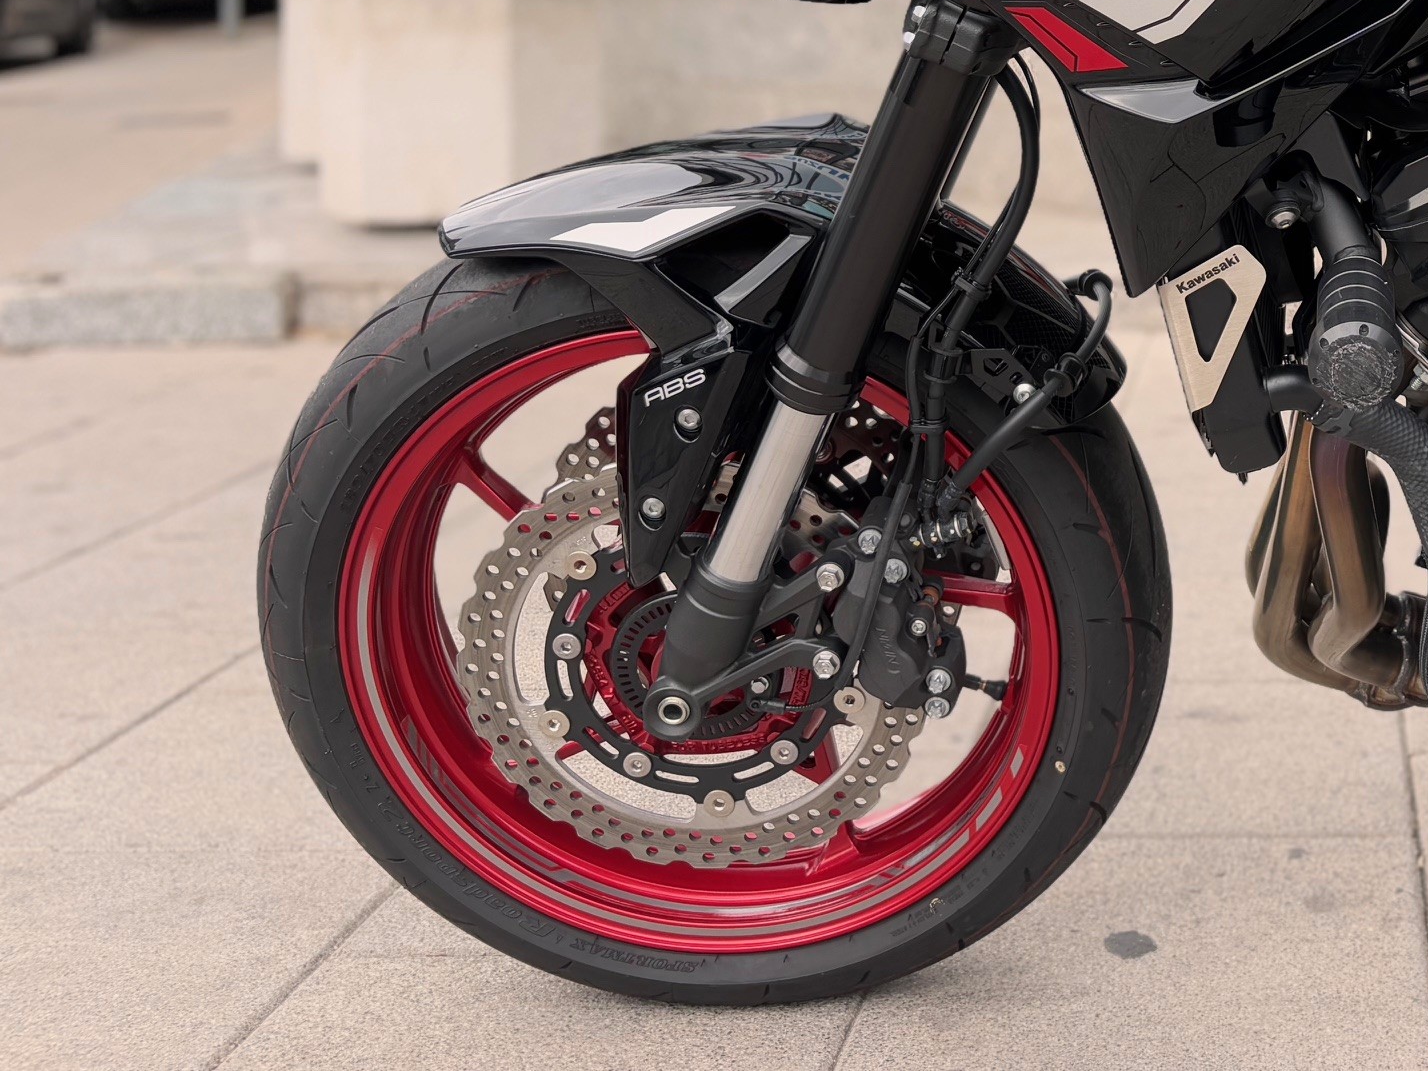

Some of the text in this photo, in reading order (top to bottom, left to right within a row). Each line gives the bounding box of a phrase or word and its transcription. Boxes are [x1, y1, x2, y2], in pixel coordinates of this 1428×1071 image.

[1175, 253, 1241, 294] Kawasaki
[644, 368, 706, 407] ABS
[569, 937, 700, 974] SPORTMAX
